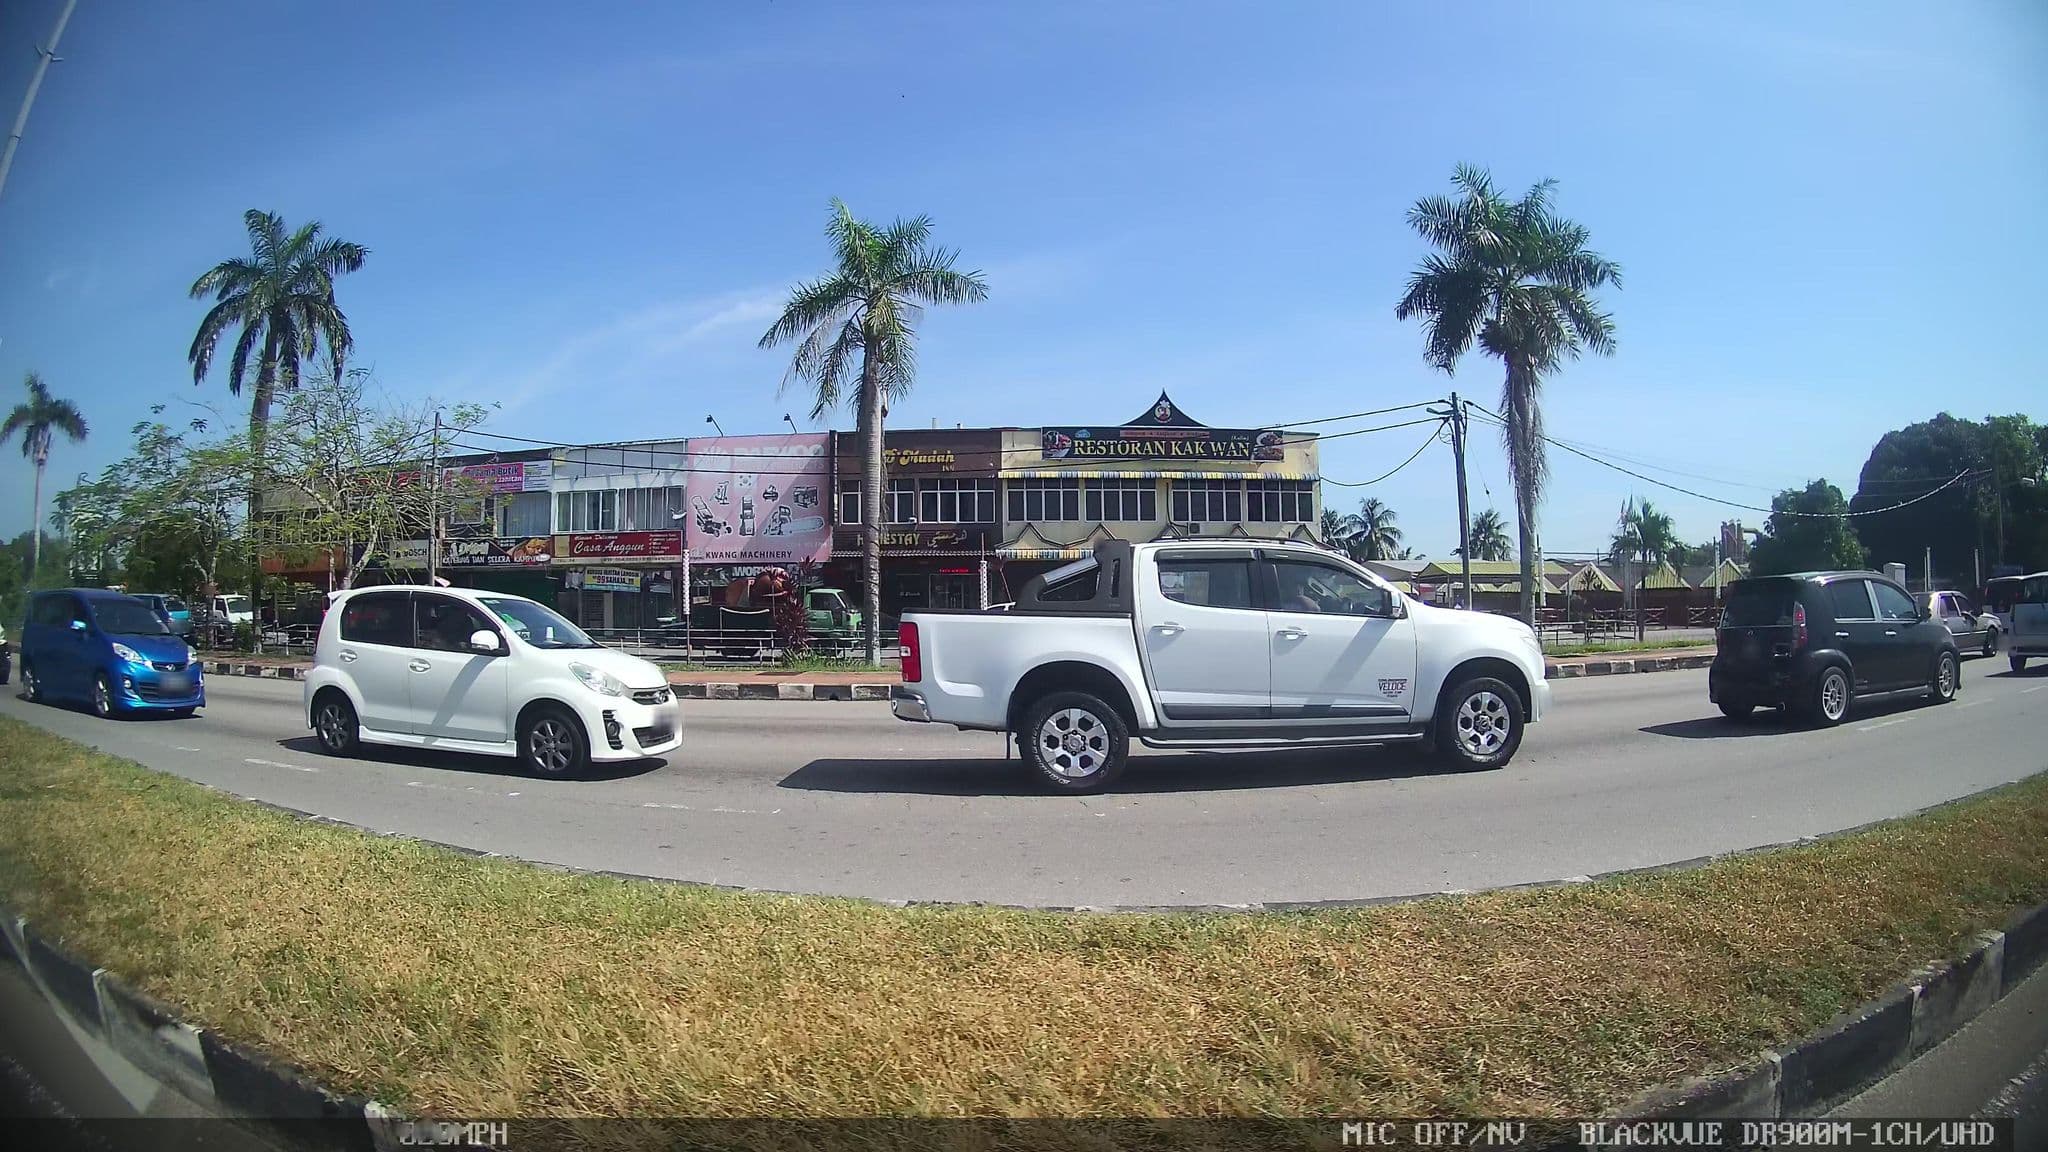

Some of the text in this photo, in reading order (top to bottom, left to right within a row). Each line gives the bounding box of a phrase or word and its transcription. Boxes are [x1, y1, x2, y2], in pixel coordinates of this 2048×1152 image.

[1074, 440, 1250, 457] RESTORAN KAK WAN
[857, 532, 920, 546] HESTAY
[574, 540, 646, 554] Casa Anggun
[705, 551, 737, 559] KWANG
[740, 550, 793, 559] MACHINERY
